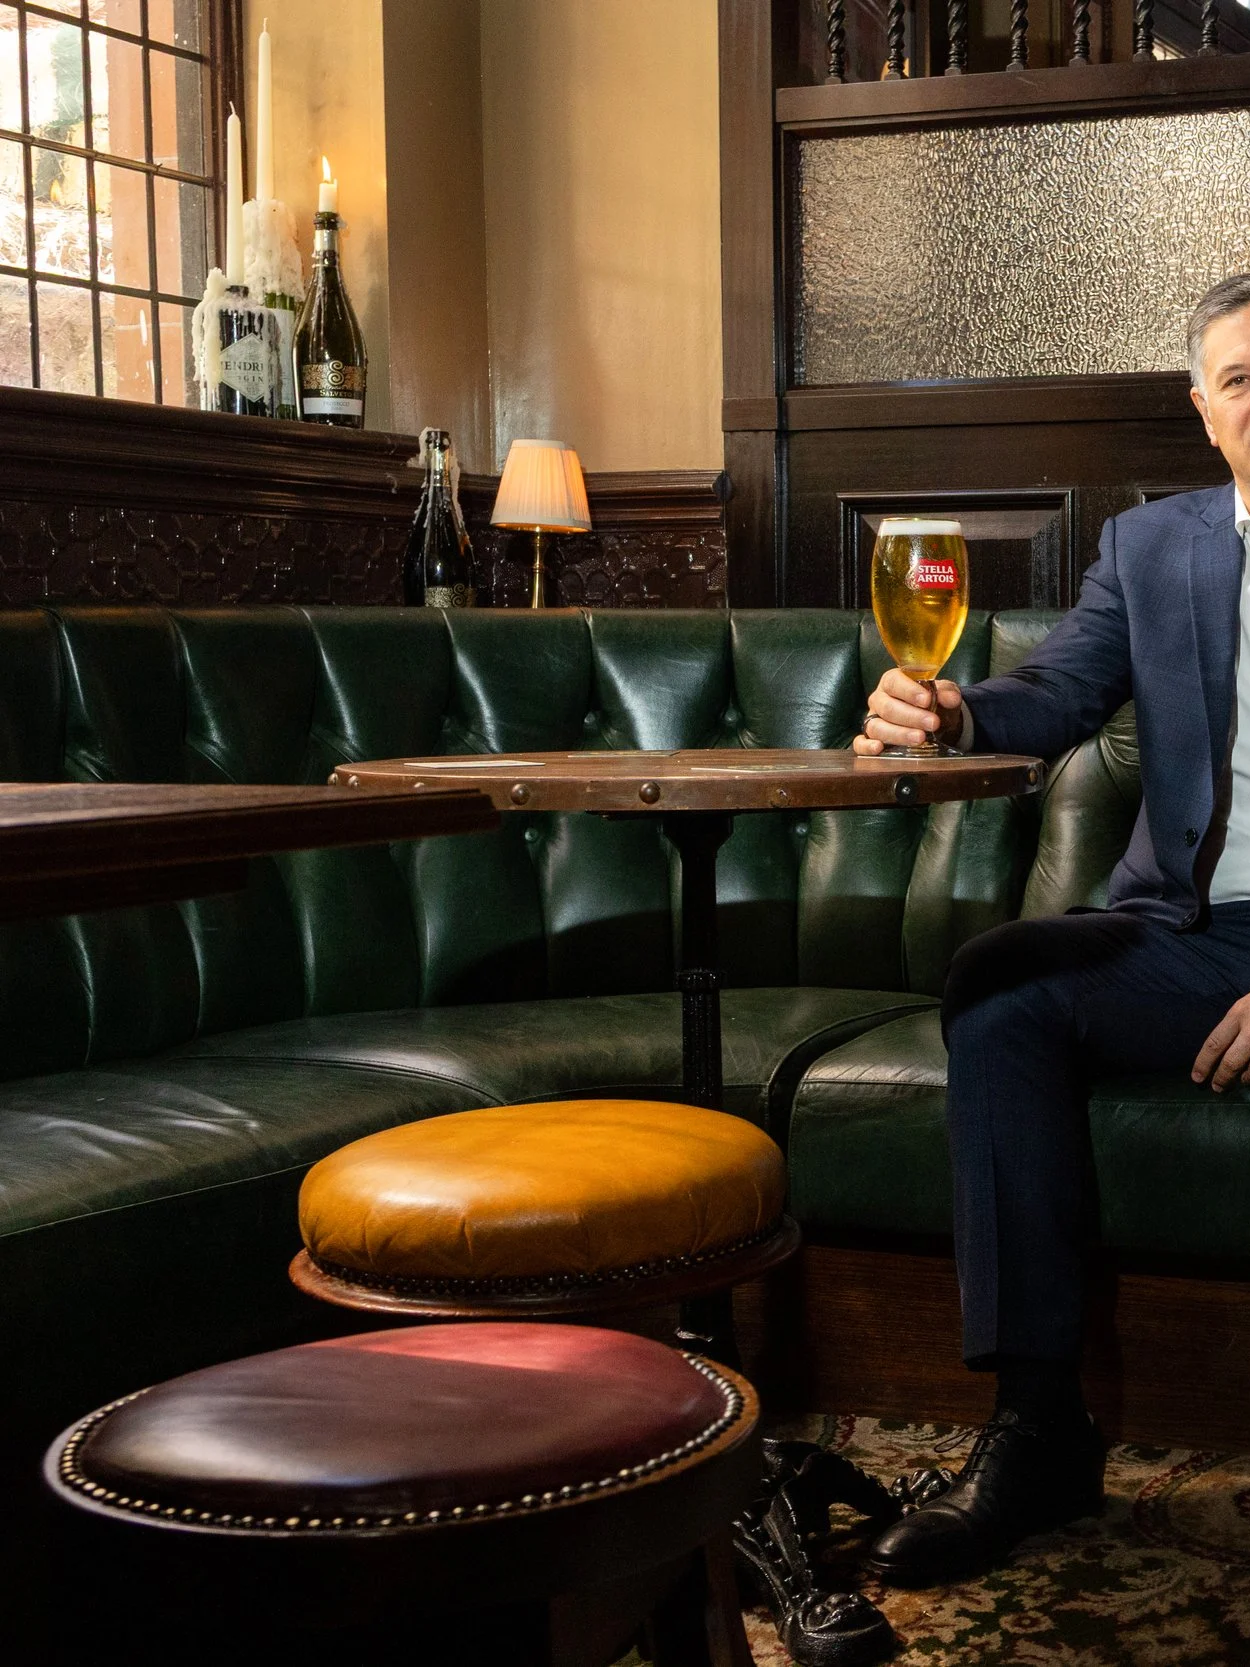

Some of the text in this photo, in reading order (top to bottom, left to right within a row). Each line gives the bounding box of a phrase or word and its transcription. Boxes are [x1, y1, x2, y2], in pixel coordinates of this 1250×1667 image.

[220, 361, 264, 371] ENDRI
[243, 375, 264, 383] GIN
[918, 565, 954, 574] STELLA
[917, 574, 954, 583] ARTOIS
